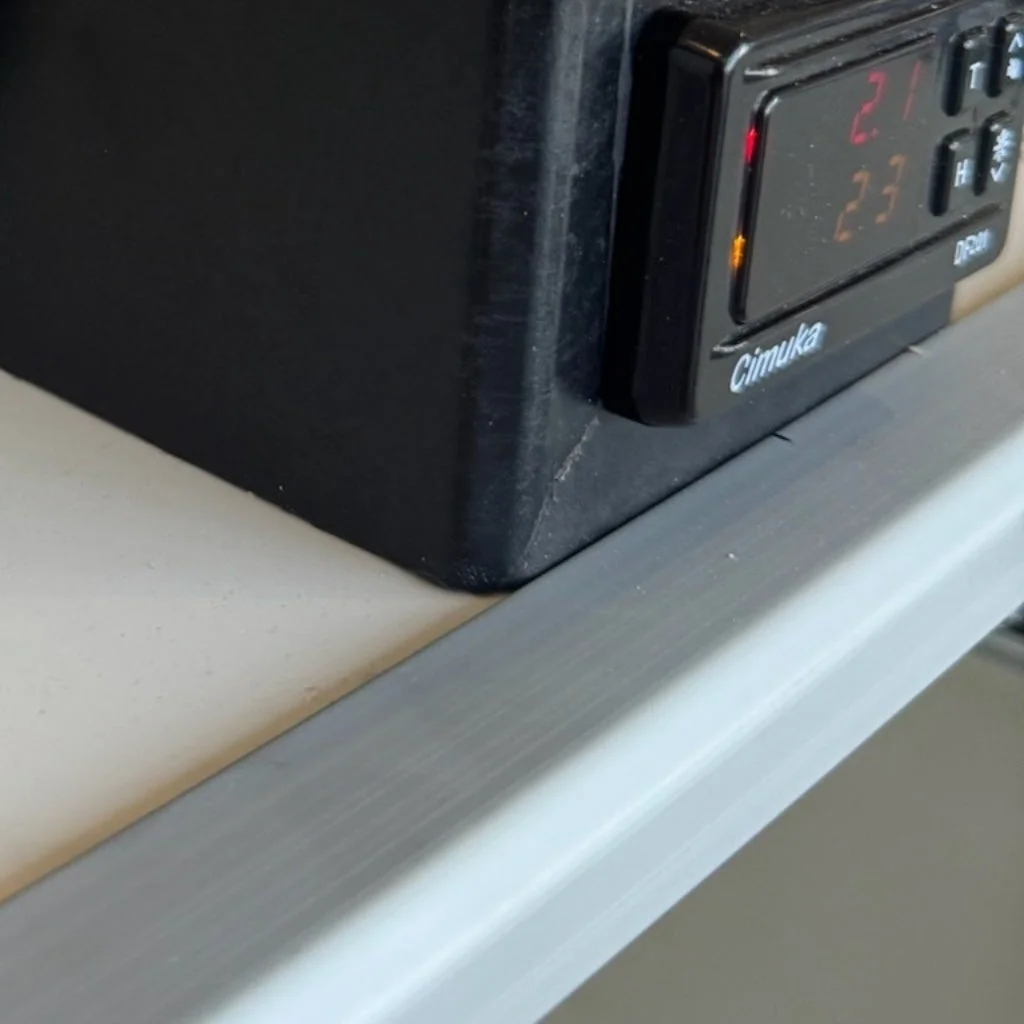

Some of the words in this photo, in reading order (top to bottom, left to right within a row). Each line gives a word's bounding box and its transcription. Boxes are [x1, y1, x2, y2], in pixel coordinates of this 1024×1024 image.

[848, 59, 923, 146] 21
[834, 154, 908, 243] 23
[730, 322, 826, 393] Cimuka
